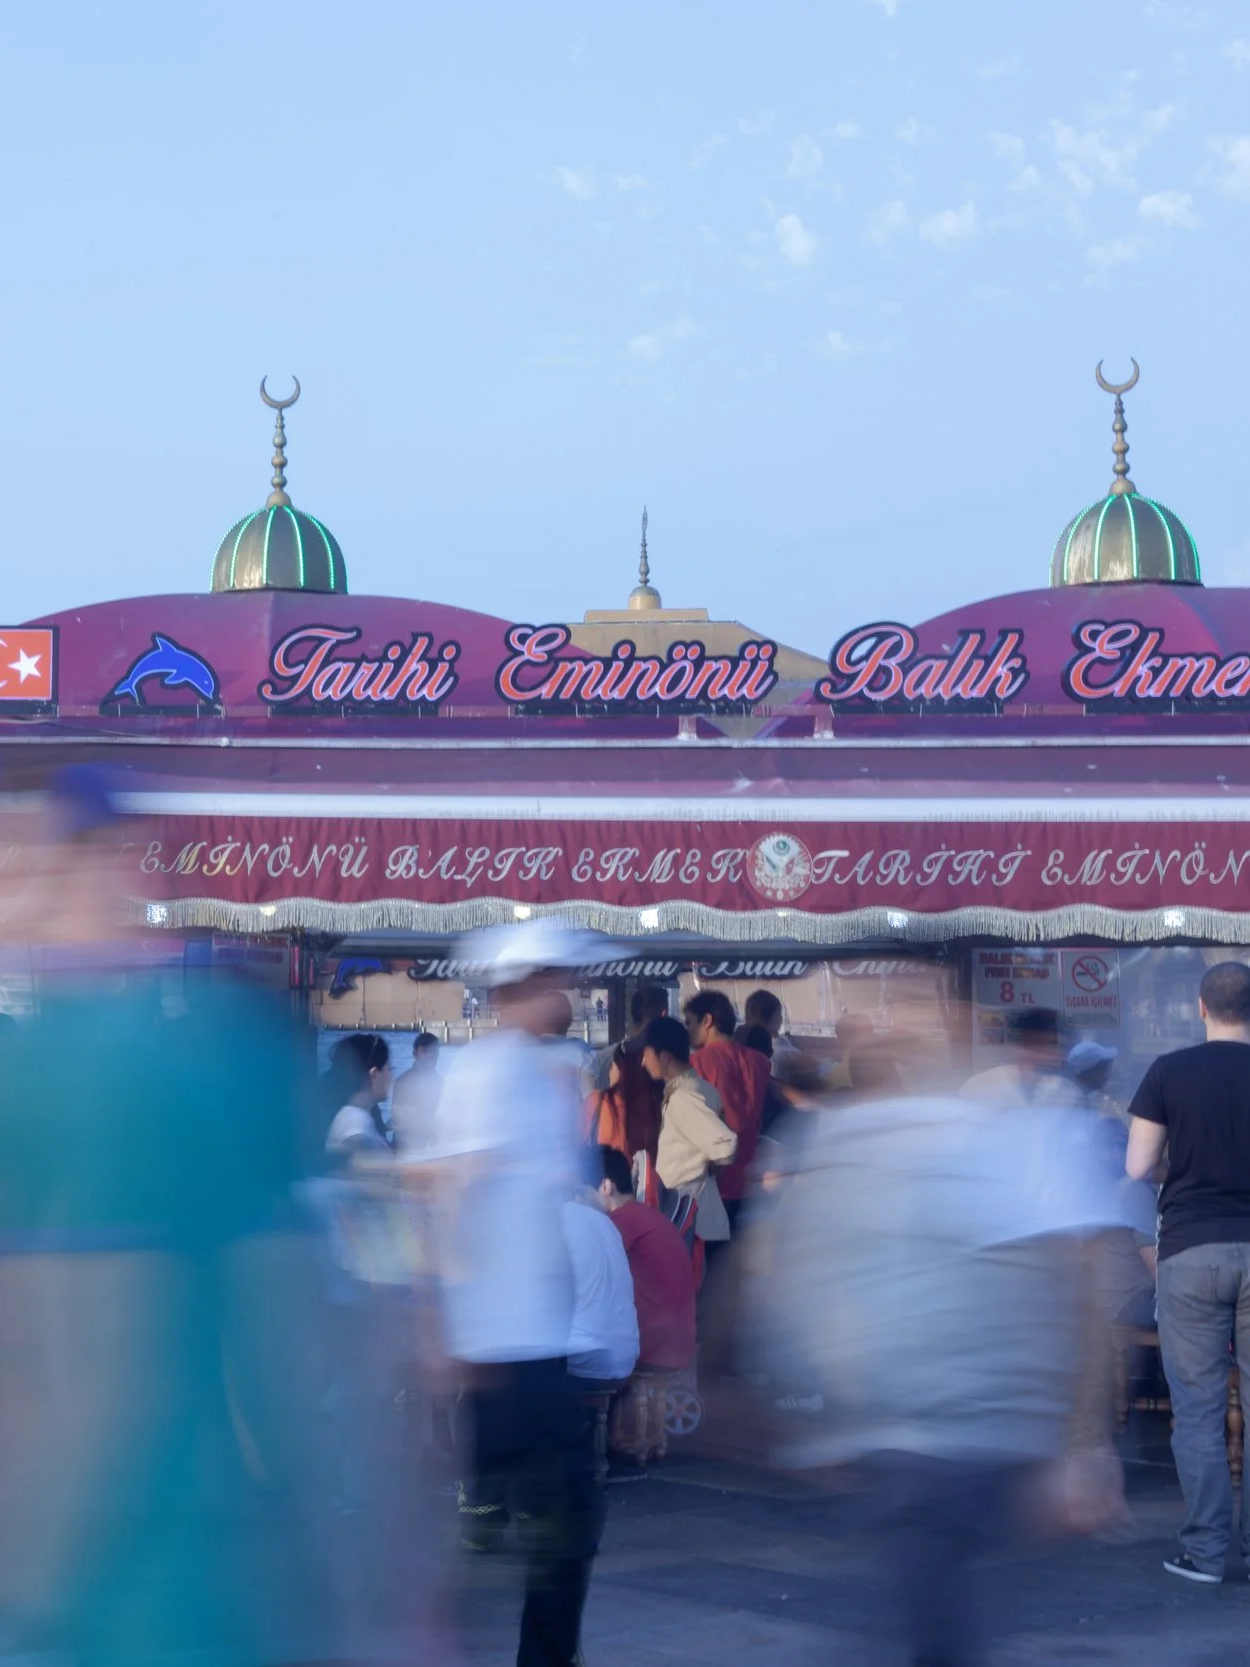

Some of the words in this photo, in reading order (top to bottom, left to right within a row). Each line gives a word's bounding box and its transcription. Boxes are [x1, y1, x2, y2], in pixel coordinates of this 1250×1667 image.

[261, 627, 455, 702] Tarihi
[499, 626, 775, 701] Eminönü
[820, 624, 1026, 700] Balık
[1069, 622, 1250, 699] Ekme
[139, 835, 370, 878] EMİNÖNÜ
[385, 844, 564, 888] BALIK
[571, 847, 750, 884] EKMEK
[811, 843, 1033, 886] TARİHİ
[1000, 981, 1015, 1003] 8
[1021, 993, 1036, 1004] TL
